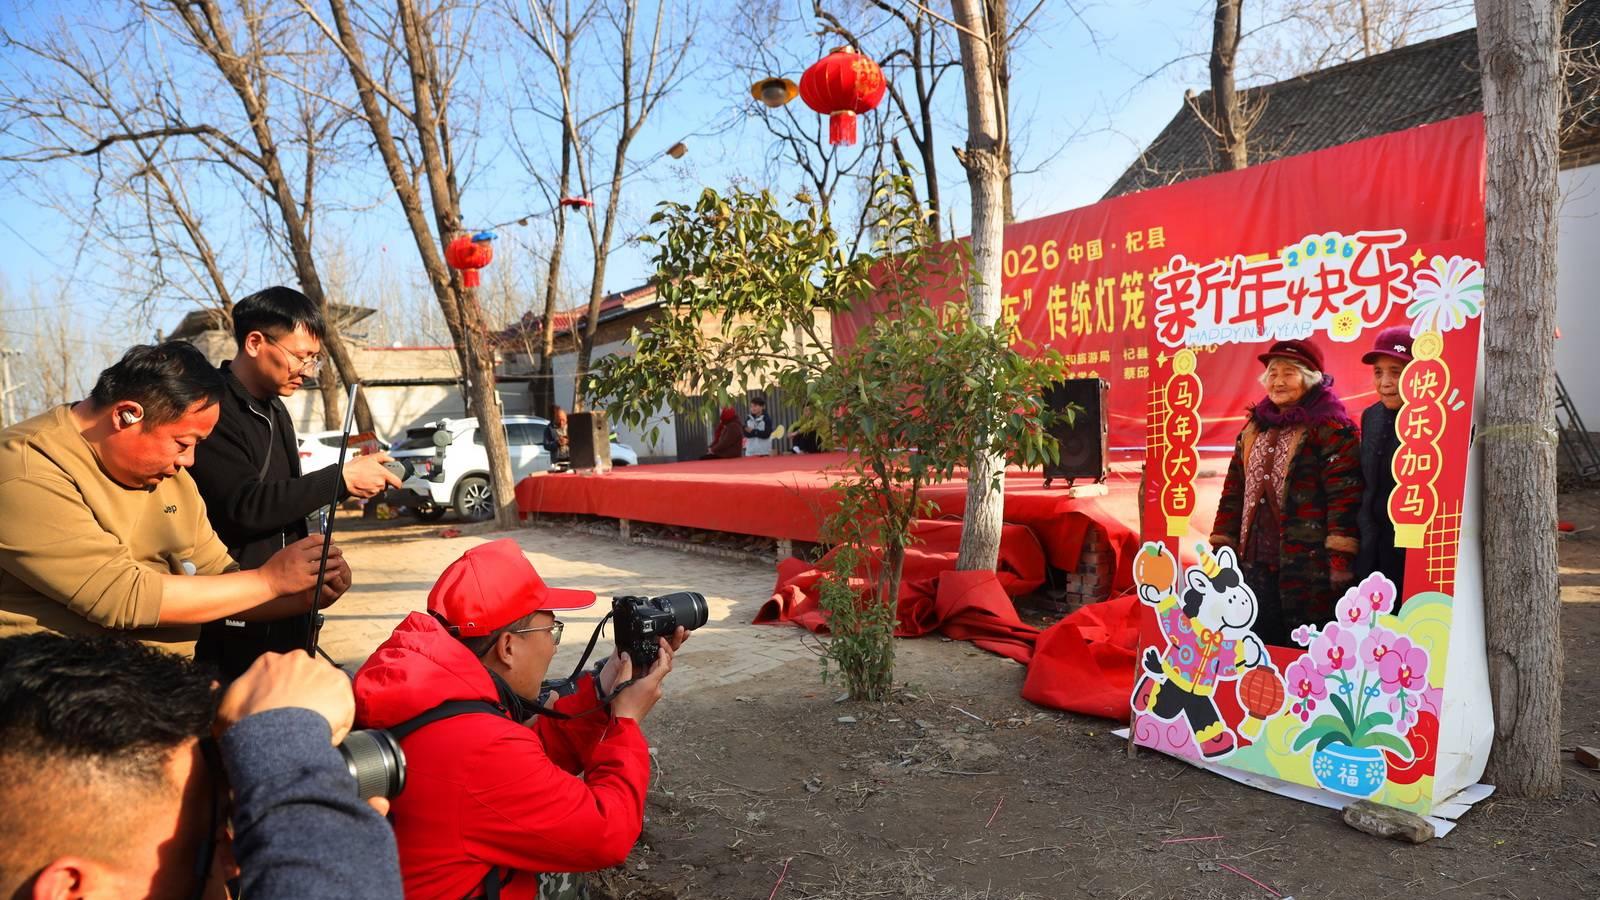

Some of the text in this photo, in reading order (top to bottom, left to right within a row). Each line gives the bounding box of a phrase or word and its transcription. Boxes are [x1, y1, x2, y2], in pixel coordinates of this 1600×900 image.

[1003, 239, 1060, 278] 026
[1287, 238, 1354, 267] 2026
[1157, 233, 1410, 338] 新年快乐
[1276, 321, 1313, 336] YEAR
[1170, 381, 1194, 510] 马年大吉
[1399, 368, 1437, 517] 快乐加马
[1337, 763, 1359, 787] 福
